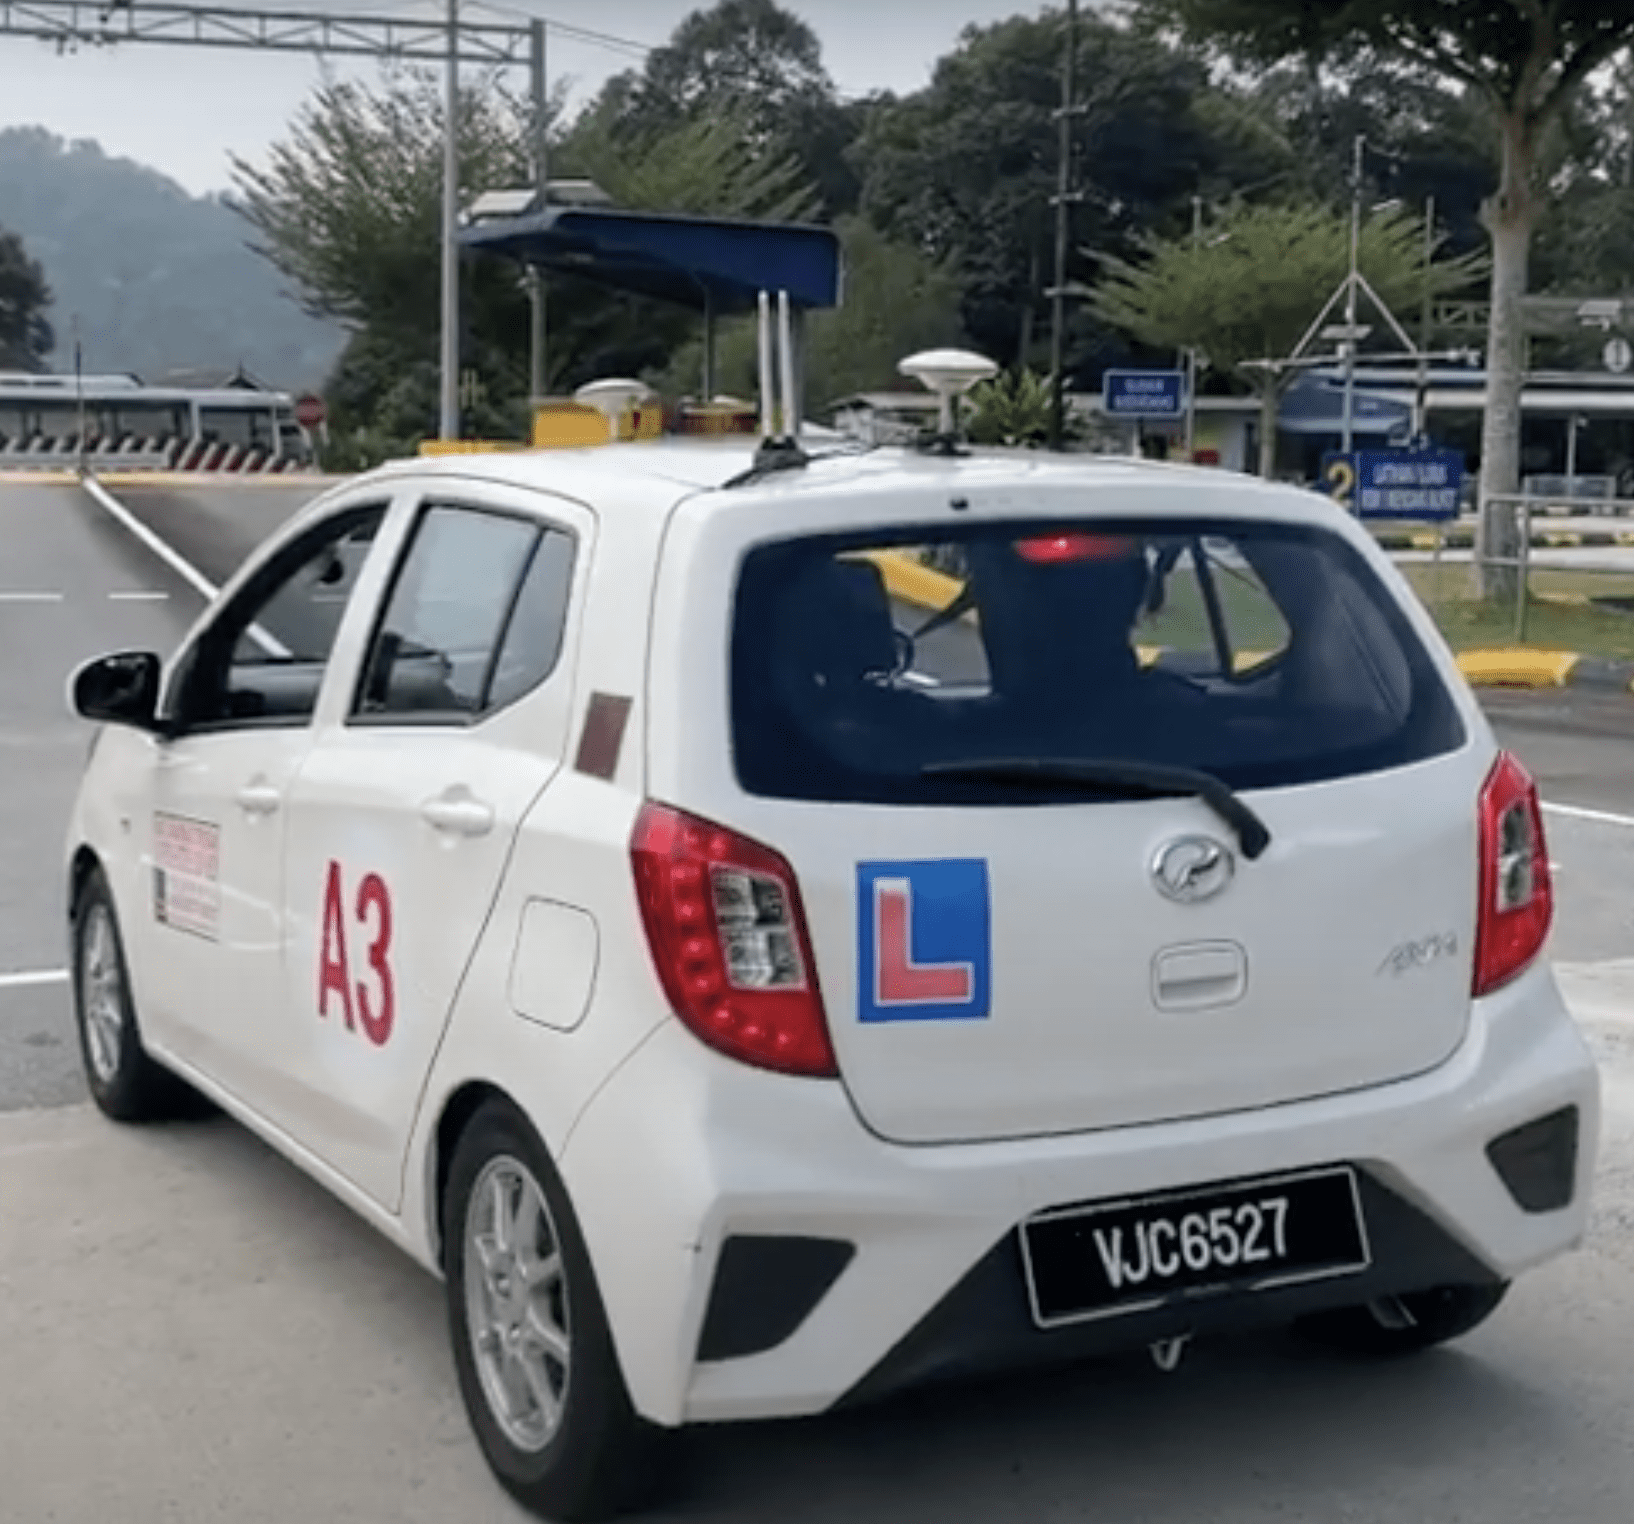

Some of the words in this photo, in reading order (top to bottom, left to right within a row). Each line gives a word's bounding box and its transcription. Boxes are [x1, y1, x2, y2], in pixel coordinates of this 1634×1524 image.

[1327, 460, 1353, 509] 2
[319, 858, 394, 1047] A3
[873, 876, 974, 1007] L
[1092, 1196, 1289, 1288] VJC6527
